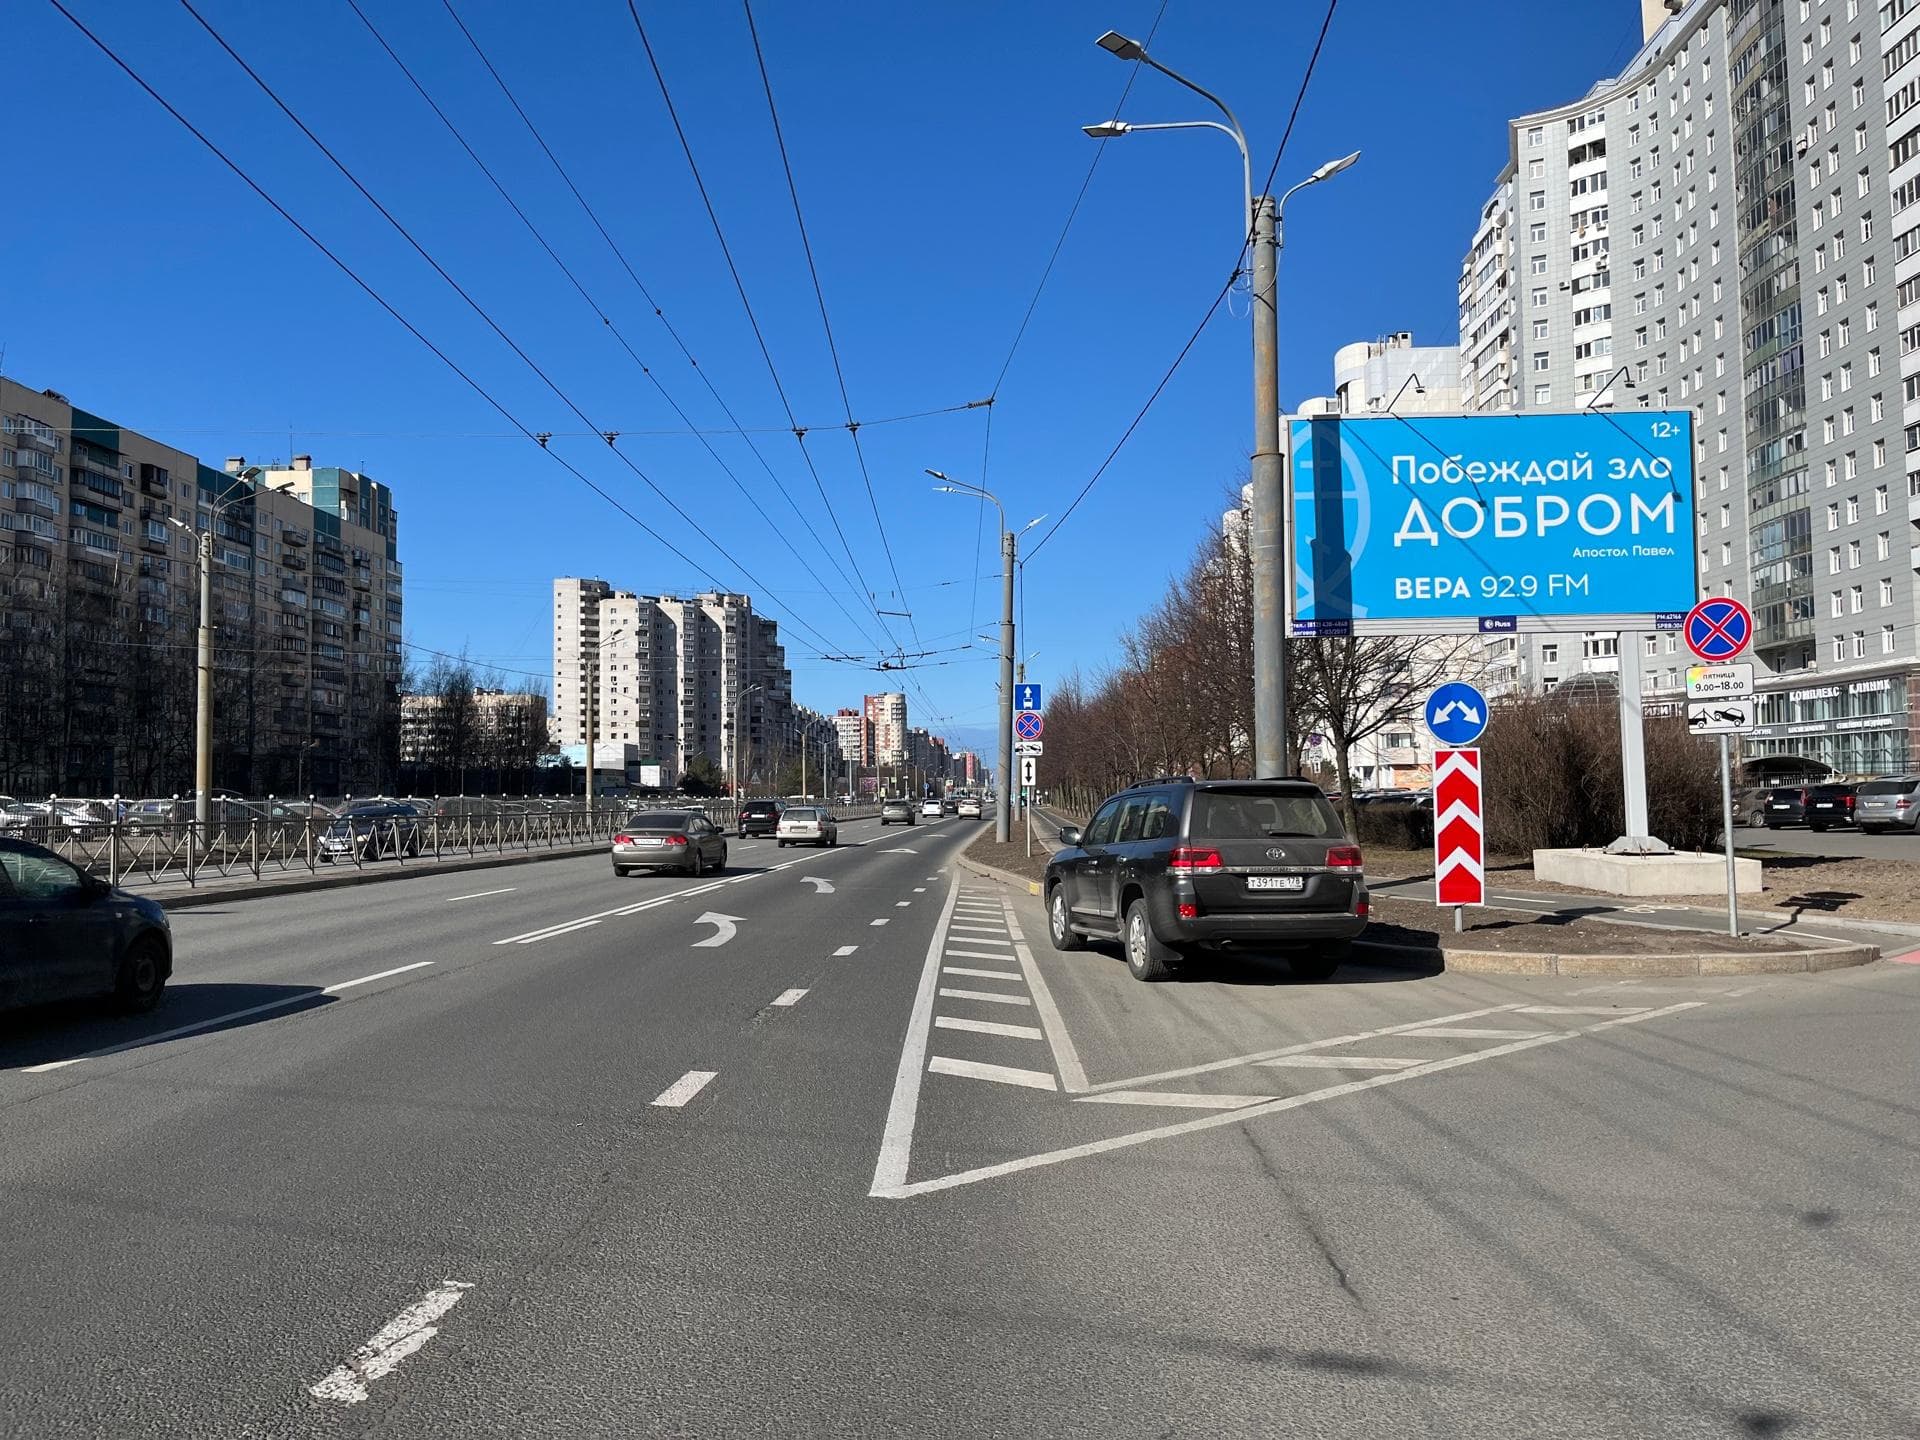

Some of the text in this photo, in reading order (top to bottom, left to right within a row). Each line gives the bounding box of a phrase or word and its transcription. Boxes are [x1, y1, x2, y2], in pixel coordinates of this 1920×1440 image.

[1651, 422, 1681, 438] 12+
[1392, 451, 1672, 486] Побеждай зло
[1393, 492, 1675, 547] ДОБРОМ
[1573, 545, 1674, 558] Апостол Павел
[1395, 574, 1589, 600] ВЕРА 92.9 FM
[1702, 671, 1736, 680] пятница
[1789, 679, 1891, 702] КОМПЛЕКС КЛИНИК
